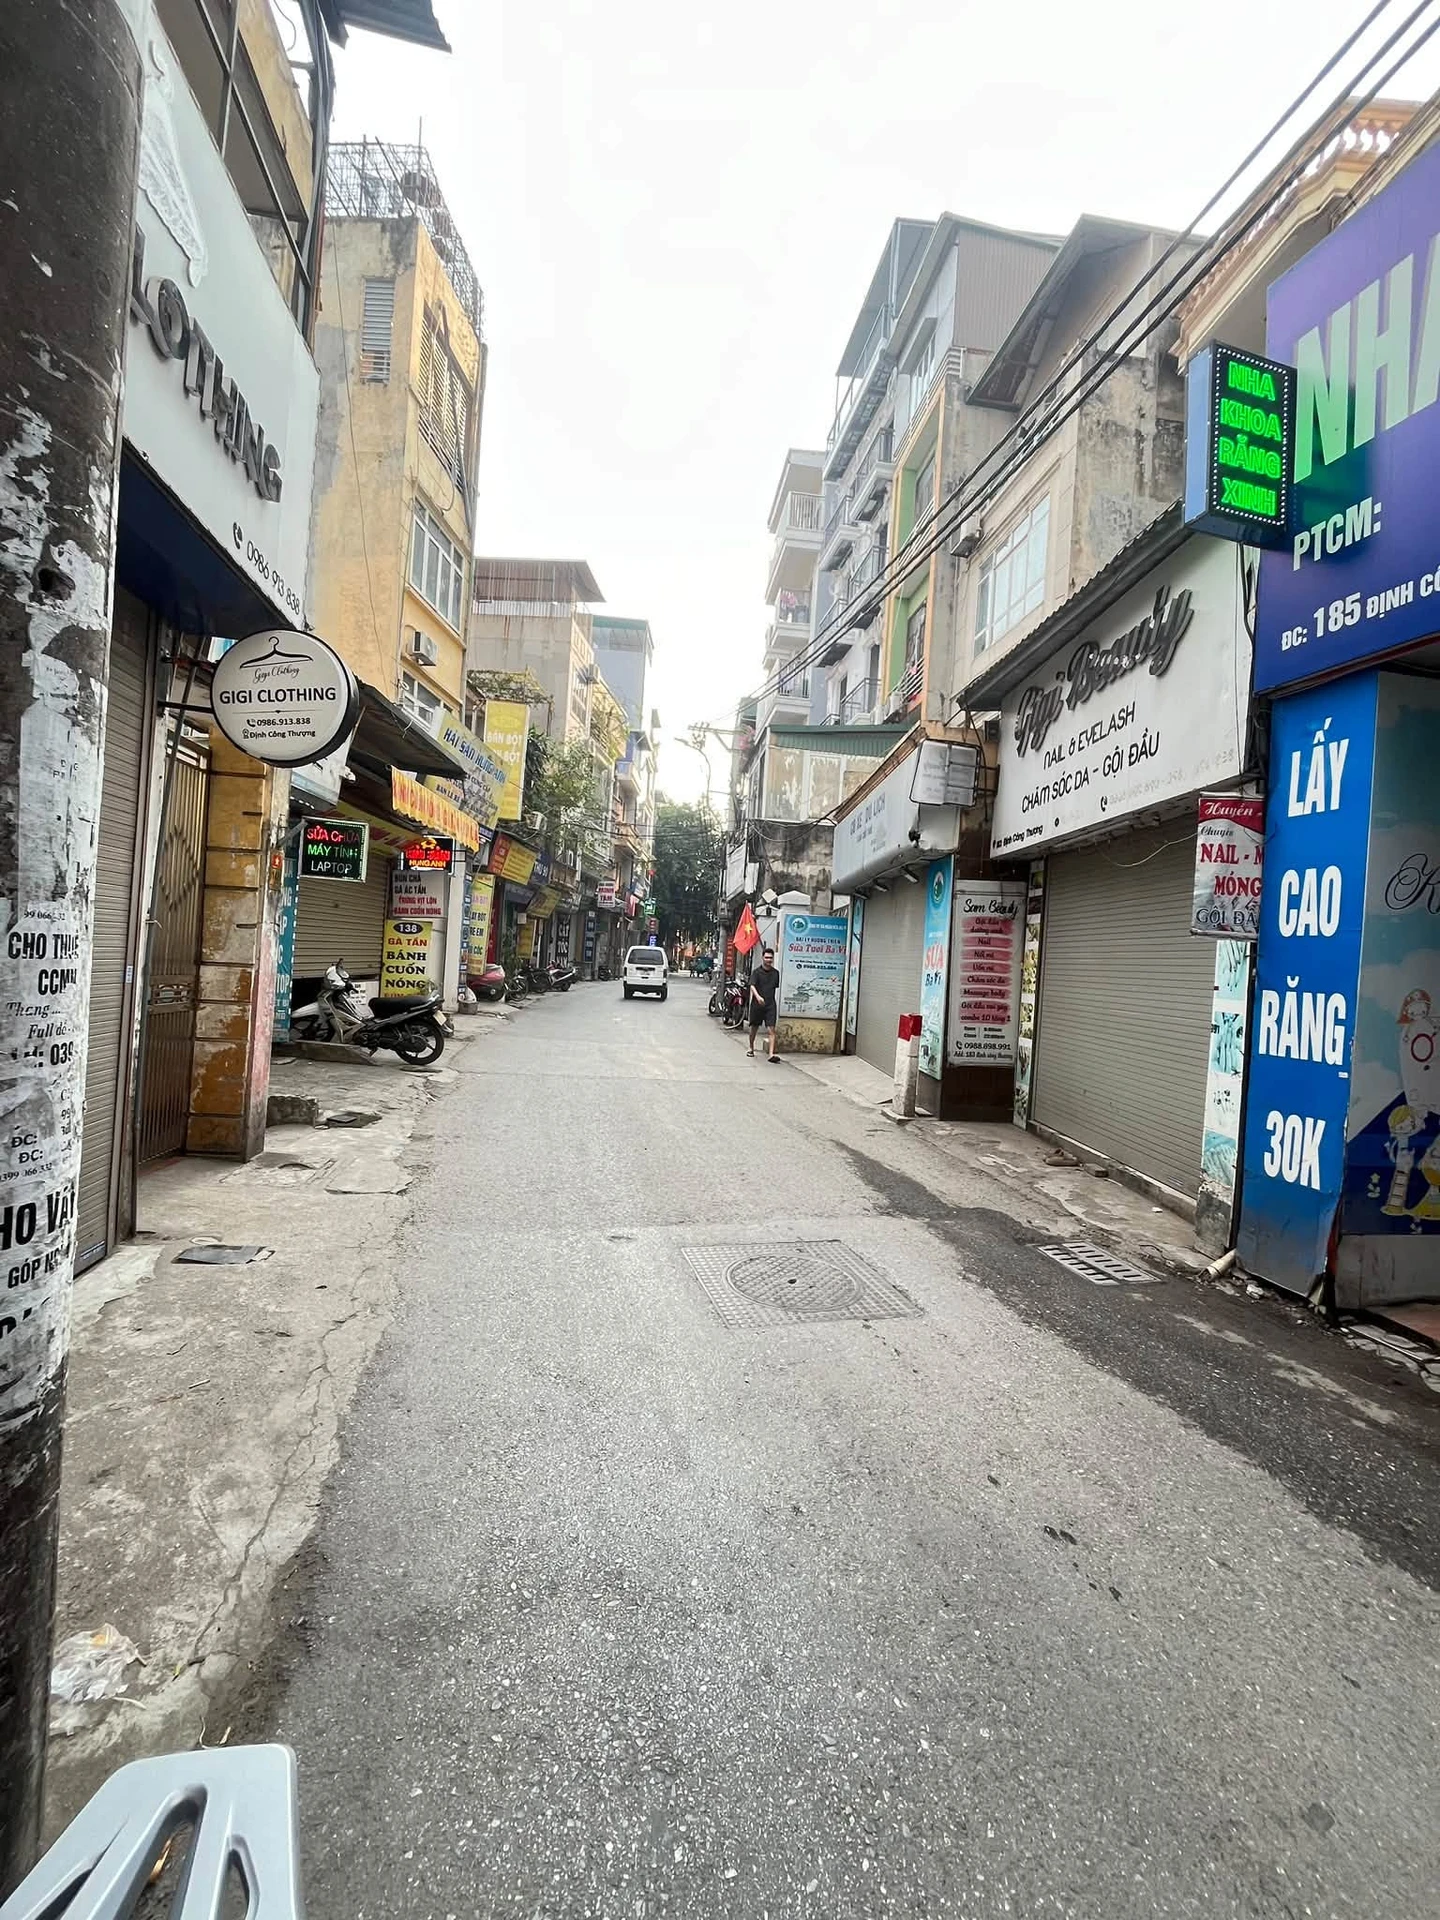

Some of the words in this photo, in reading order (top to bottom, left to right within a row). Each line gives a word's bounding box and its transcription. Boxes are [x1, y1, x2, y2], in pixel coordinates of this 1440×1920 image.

[130, 223, 282, 503] LOTHING
[1228, 359, 1276, 403] NHA
[1220, 397, 1281, 442] KHOA
[1218, 433, 1281, 480] RĂNG
[1221, 476, 1277, 518] XINH
[1292, 496, 1382, 572] PTCM:
[247, 540, 270, 581] 0986
[271, 568, 286, 598] 913
[286, 587, 301, 616] 838
[1281, 626, 1308, 652] ĐC:
[1313, 592, 1361, 638] 185
[1366, 581, 1414, 619] ĐỊNH
[219, 689, 253, 705] GIGI
[257, 687, 336, 704] CLOTHING
[250, 730, 267, 740] Định
[268, 730, 286, 739] Công
[288, 730, 316, 738] Thượng
[256, 717, 311, 727] 0986.913.838
[1078, 702, 1136, 752] EYELASH
[1022, 783, 1051, 814] CHĂM
[1051, 769, 1073, 804] SÓC
[1073, 768, 1090, 791] DA
[1103, 750, 1124, 782] GỘI
[1128, 727, 1161, 766] ĐẦU
[1287, 717, 1350, 819] LẤY
[307, 825, 329, 840] SỬA
[307, 842, 332, 856] MÁY
[1200, 843, 1239, 865] NAIL
[311, 860, 352, 874] LAPTOP
[1214, 871, 1262, 898] MÓNG
[1278, 864, 1343, 938] CAO
[399, 922, 418, 933] 138
[1195, 906, 1227, 928] GỘI
[8, 931, 47, 960] CHO
[386, 949, 427, 961] BÁNH
[924, 942, 944, 970] SỮA
[385, 961, 426, 975] CUỐN
[276, 973, 291, 994] TOP
[385, 976, 426, 989] NÓNG
[27, 1023, 53, 1040] Full
[1258, 975, 1346, 1066] RĂNG
[11, 1133, 38, 1147] ĐC:
[1263, 1109, 1327, 1191] 30K
[18, 1149, 44, 1164] ĐC:
[0, 1200, 37, 1252] HO
[8, 1253, 40, 1289] GÓP
